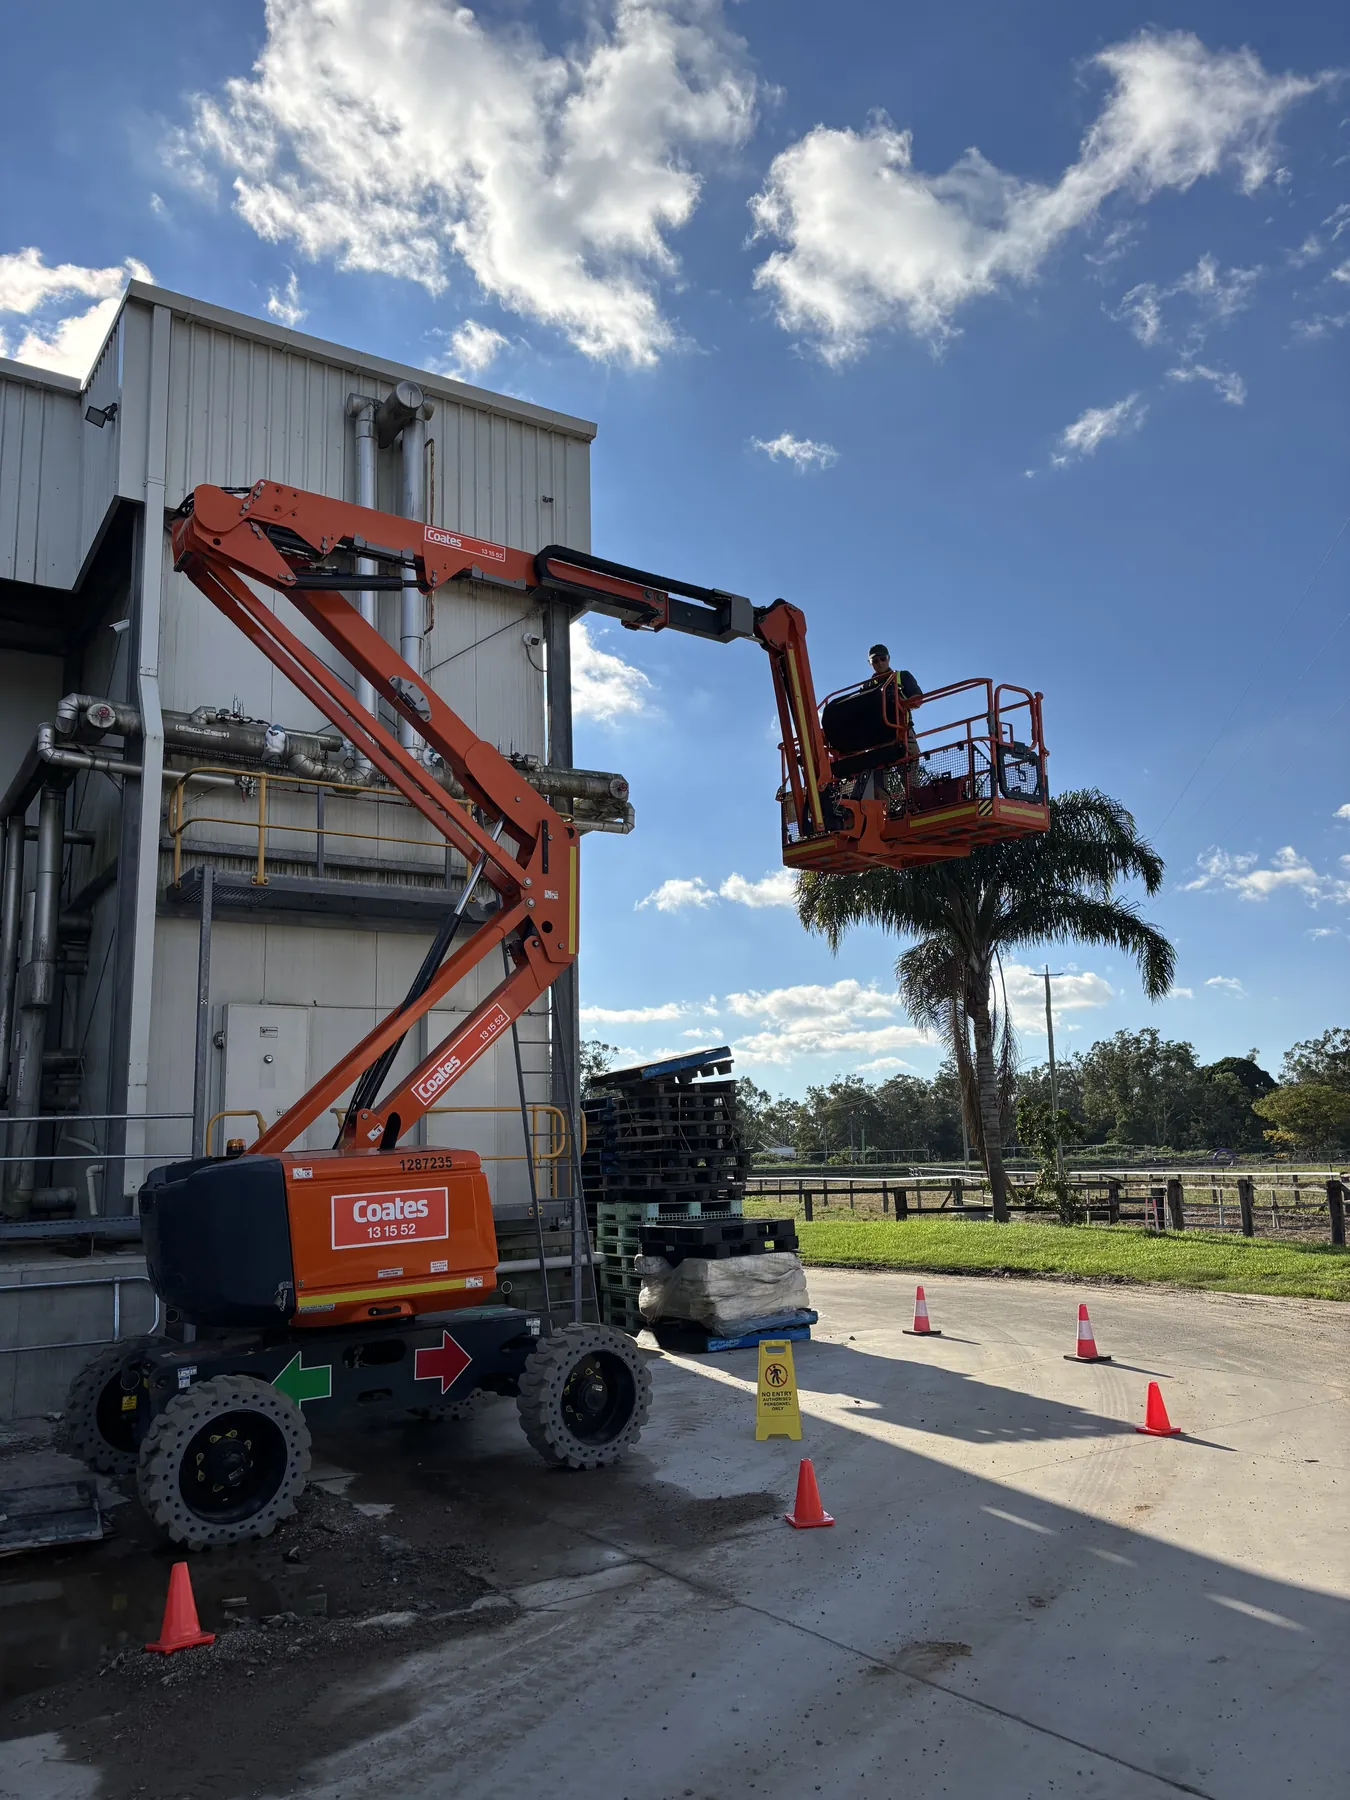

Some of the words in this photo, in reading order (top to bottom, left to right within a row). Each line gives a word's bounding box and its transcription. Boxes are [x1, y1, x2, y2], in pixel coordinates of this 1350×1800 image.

[428, 530, 462, 547] Coates
[418, 1056, 460, 1098] Coates
[480, 1030, 489, 1040] 13
[487, 1023, 496, 1032] 15
[494, 1014, 505, 1025] 52
[400, 1157, 452, 1171] 1287235
[353, 1198, 428, 1223] Coates
[367, 1226, 381, 1238] 13
[384, 1225, 397, 1236] 15
[400, 1223, 416, 1235] 52
